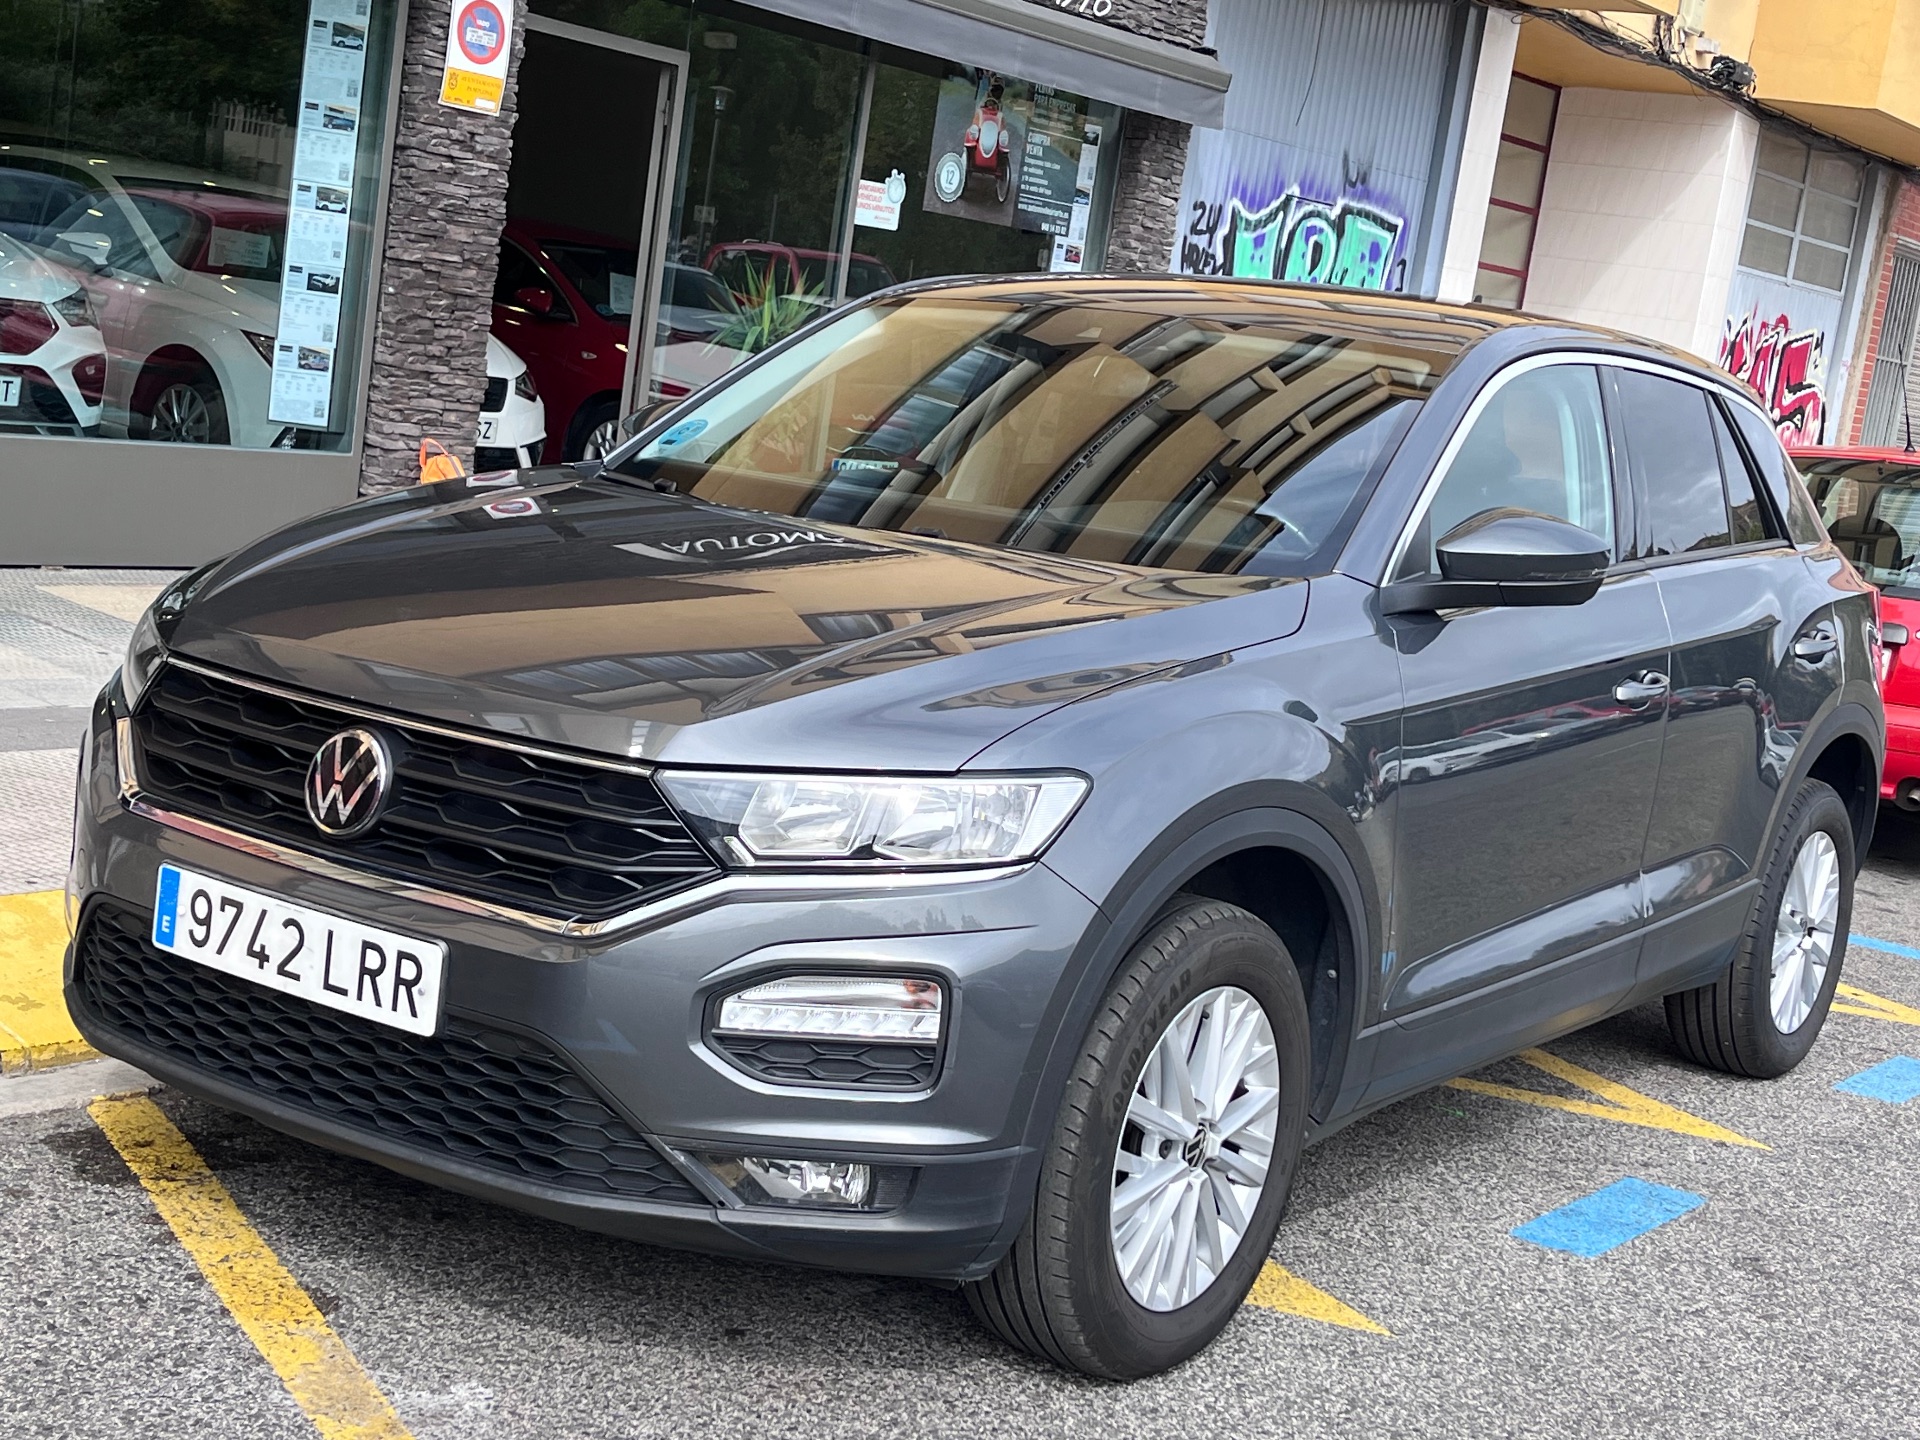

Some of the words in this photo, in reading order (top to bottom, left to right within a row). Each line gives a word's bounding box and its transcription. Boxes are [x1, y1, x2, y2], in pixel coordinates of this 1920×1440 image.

[946, 169, 955, 185] 12
[161, 915, 171, 933] E
[188, 888, 305, 982] 9742
[322, 929, 422, 1019] LRR
